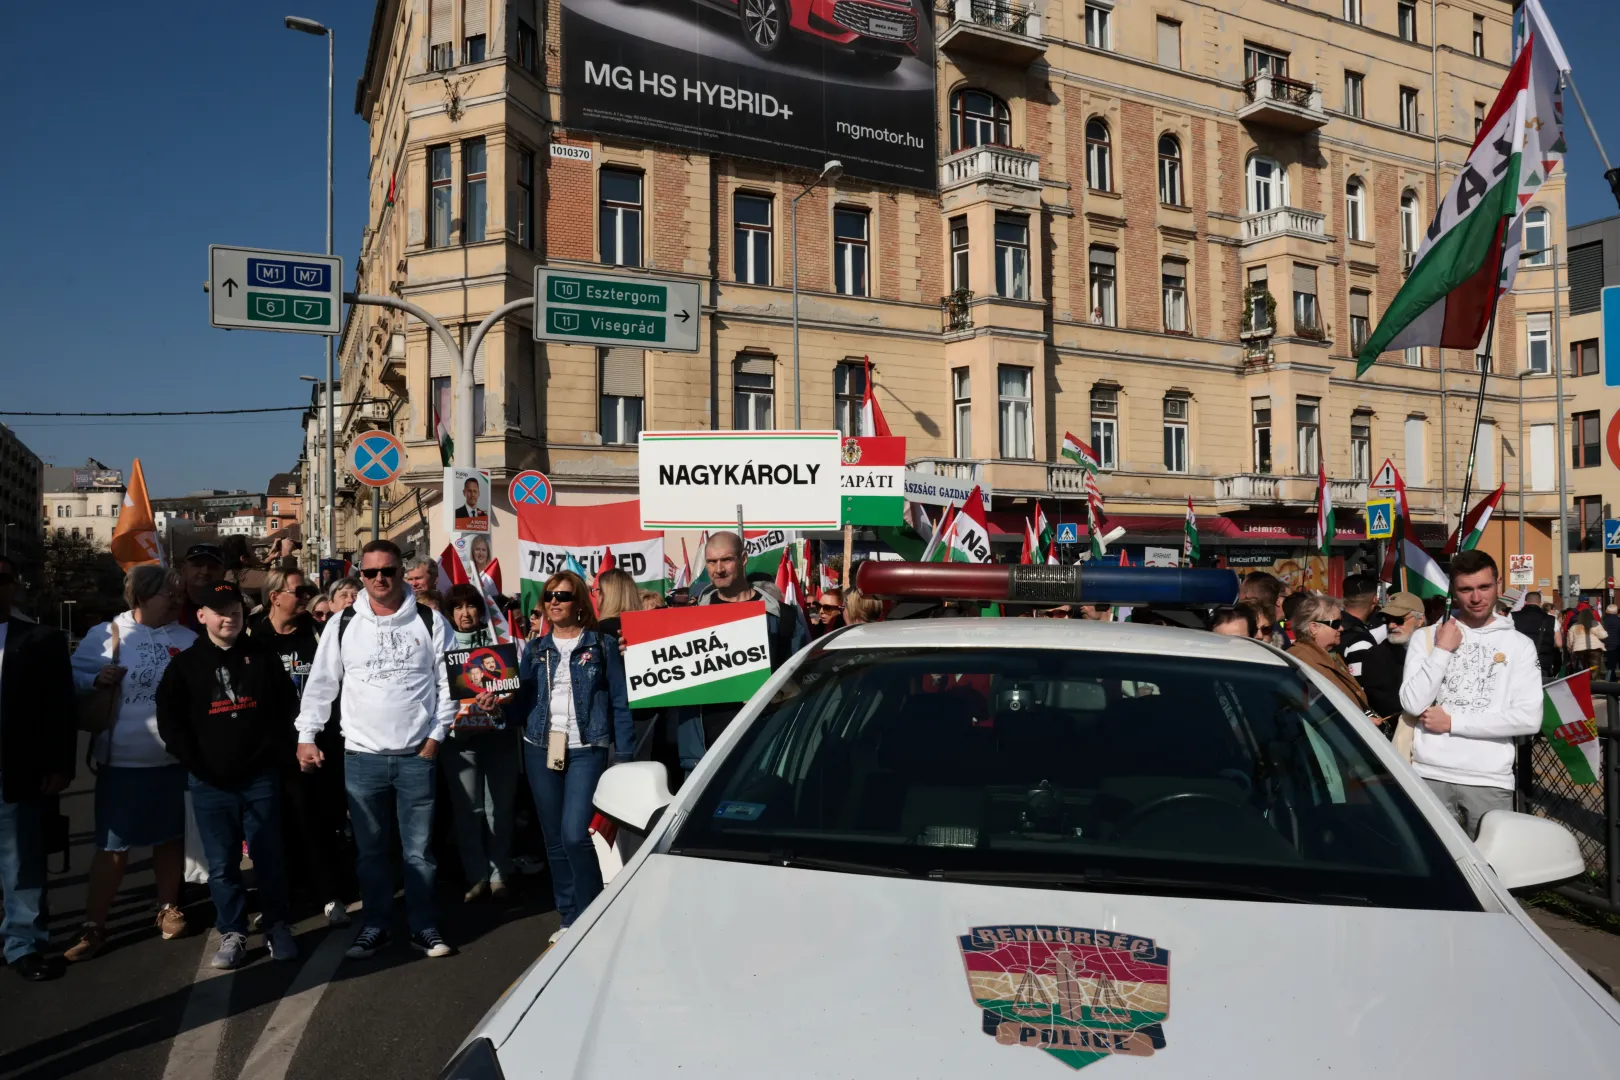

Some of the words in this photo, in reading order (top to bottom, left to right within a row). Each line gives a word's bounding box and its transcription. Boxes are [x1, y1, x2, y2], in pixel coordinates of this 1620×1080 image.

[584, 60, 633, 91] MG
[639, 69, 677, 98] HS
[683, 78, 794, 120] HYBRID+
[836, 119, 924, 149] mgmotor.hu
[552, 146, 590, 159] 1010370
[263, 267, 279, 279] M1
[300, 270, 317, 282] M7
[561, 284, 573, 295] 10
[586, 285, 660, 305] Esztergom
[266, 301, 275, 313] 6
[304, 304, 313, 315] 7
[562, 316, 571, 327] 11
[591, 317, 655, 335] Visegrád
[659, 459, 821, 485] NAGYKÁROLY
[939, 487, 990, 503] GAZDAKÖK
[528, 550, 647, 578] TISZFÜED
[448, 652, 470, 666] STOP
[651, 630, 729, 665] HAJRÁ,
[629, 665, 686, 691] PÓCS
[690, 644, 768, 677] JÁNOS!
[485, 675, 520, 692] HÁBORÚ
[976, 928, 1150, 953] RENDŐRSÉG
[1019, 1026, 1132, 1051] POLICE
